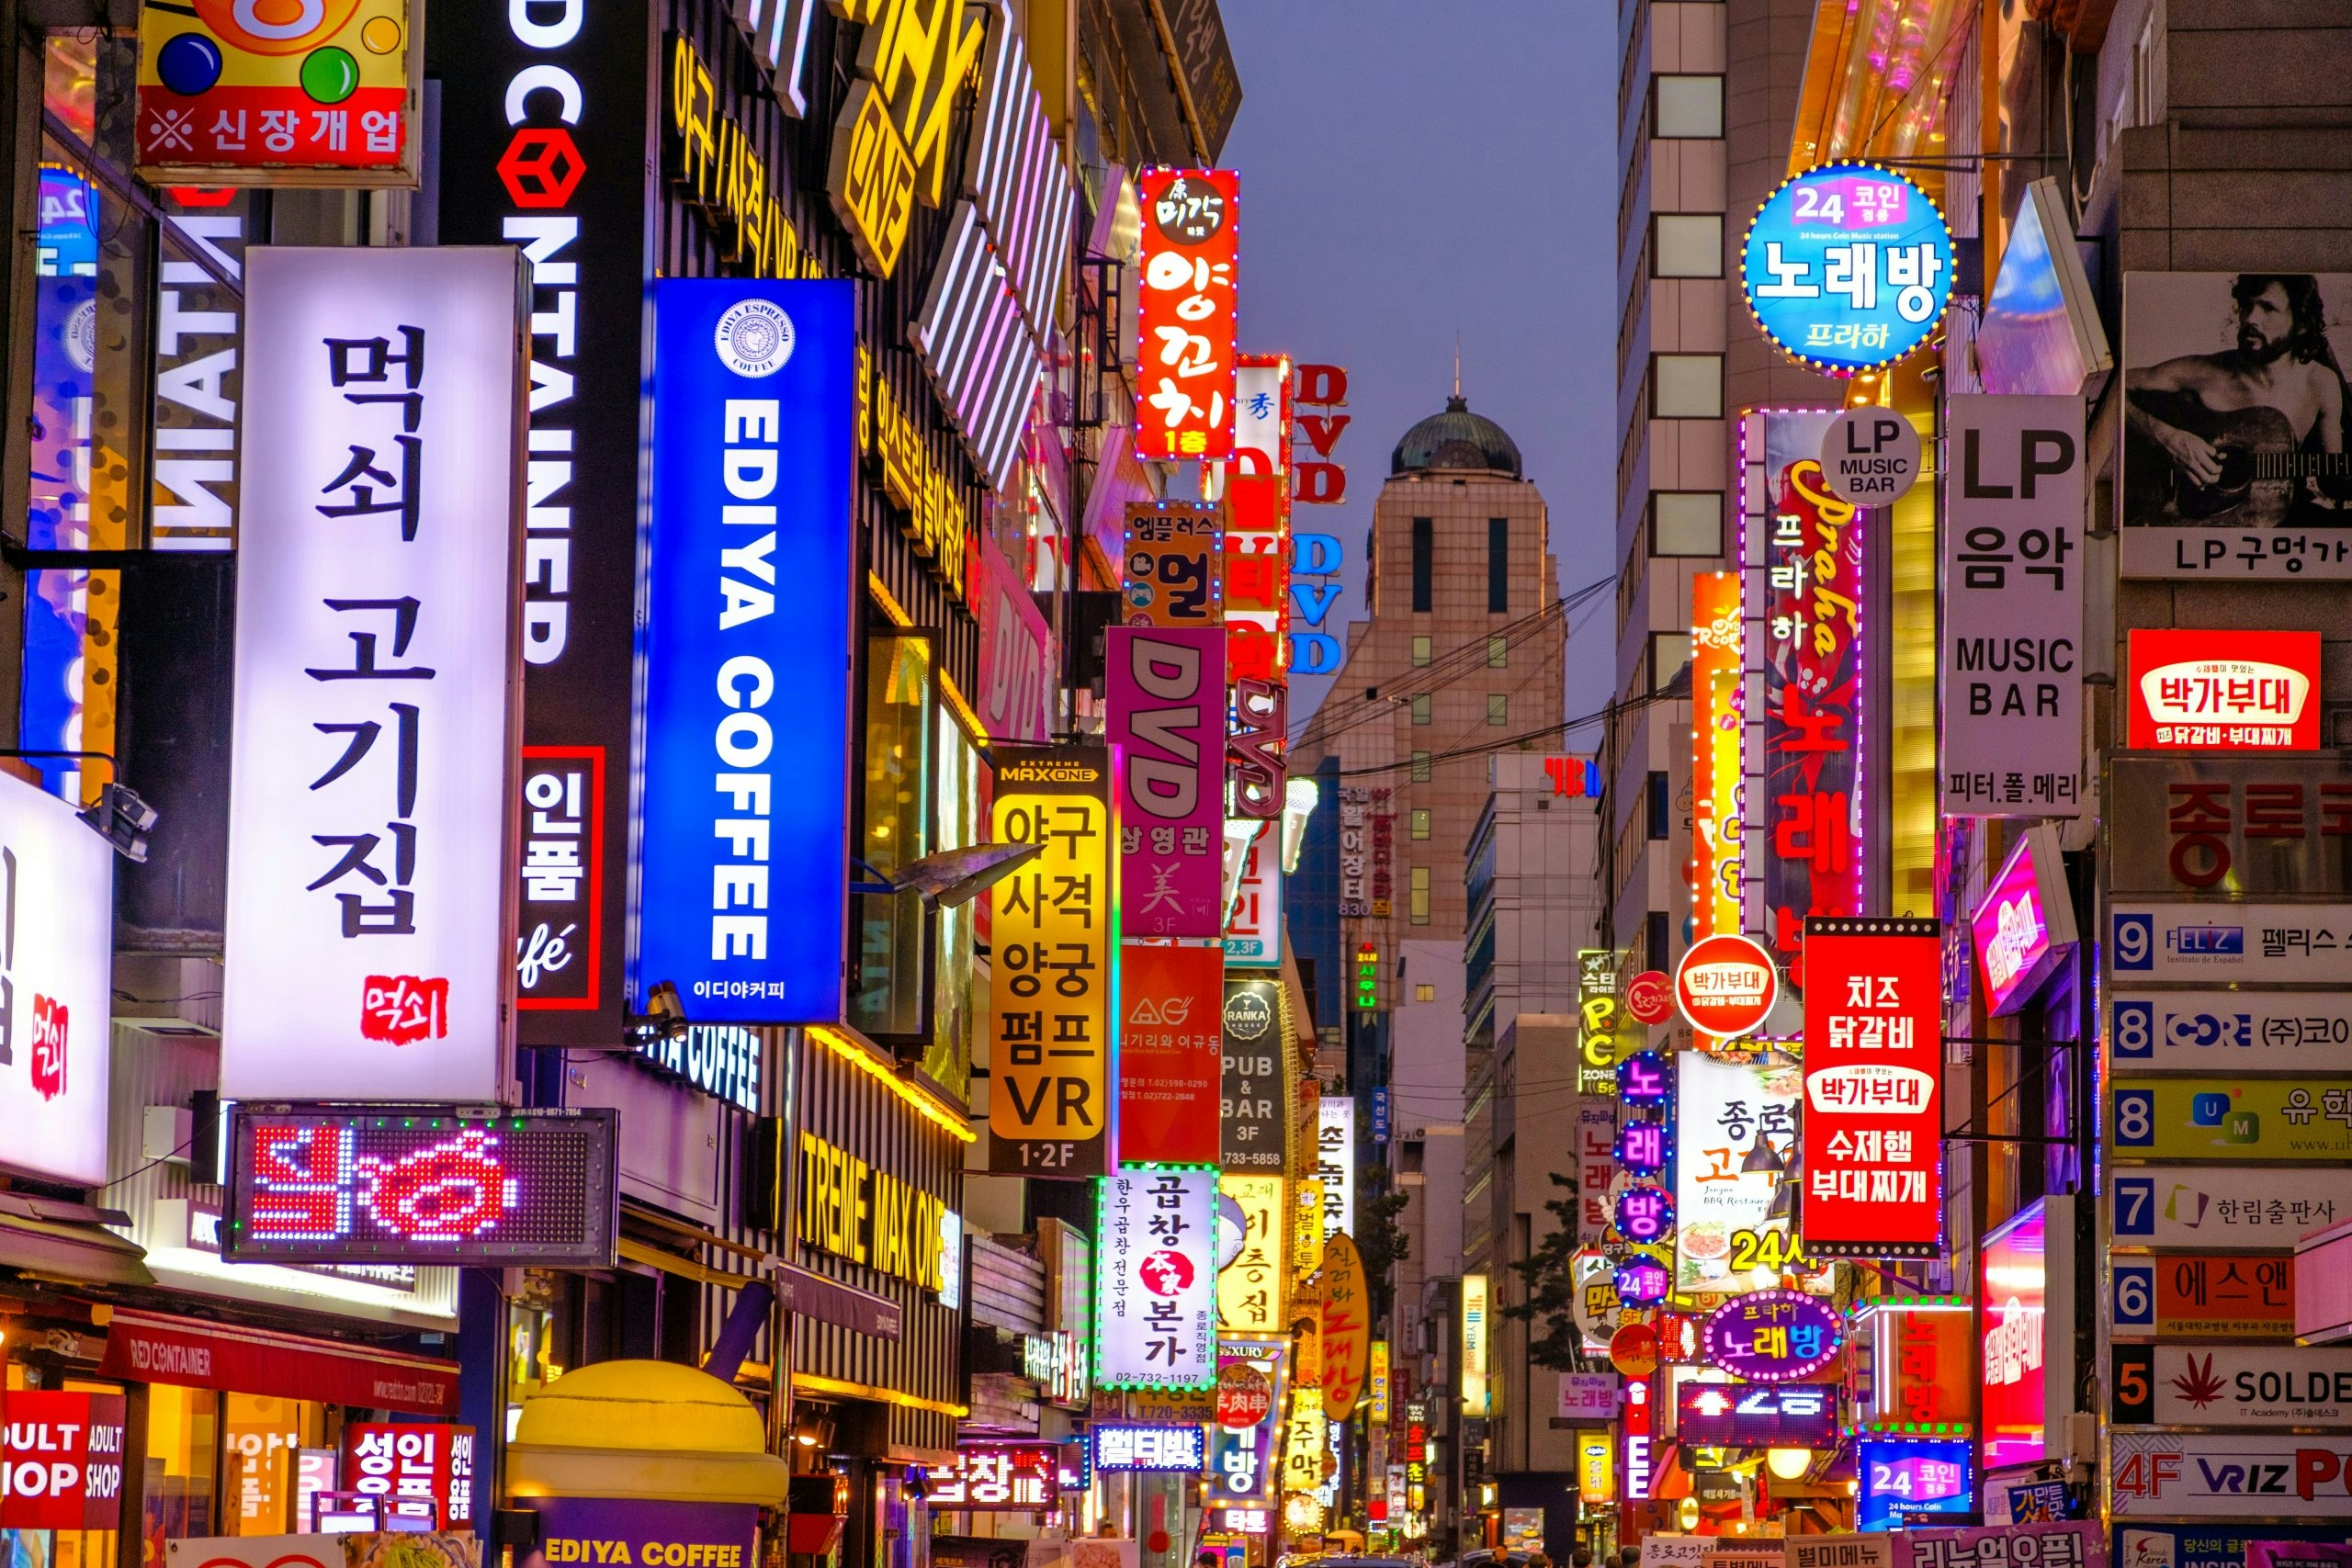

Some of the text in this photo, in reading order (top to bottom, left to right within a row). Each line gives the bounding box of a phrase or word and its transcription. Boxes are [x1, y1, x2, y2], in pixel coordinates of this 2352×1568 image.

[209, 108, 399, 152] 신장개업
[1794, 186, 1845, 224] 24
[1852, 184, 1900, 209] 코인
[1800, 231, 1899, 240] 24 hours Coin Music station
[1756, 242, 1943, 322] 노래방
[1147, 250, 1231, 428] 양꼬치
[1804, 323, 1890, 349] 프라하
[1164, 430, 1208, 454] 1층
[1292, 363, 1351, 504] DVD
[1847, 420, 1900, 455] LP
[1839, 458, 1908, 475] MUSIC
[1962, 428, 2076, 500] LP
[1849, 477, 1895, 493] BAR
[1133, 515, 1215, 541] 엠플러스
[1956, 526, 2075, 592] 음악
[2177, 539, 2226, 570] LP
[1770, 514, 1809, 650] 프라하
[1290, 533, 1344, 675] DVD
[304, 324, 435, 940] 먹쇠 고기집
[1956, 637, 2075, 673] MUSIC
[710, 399, 780, 961] EDIYA COFFEE
[2160, 677, 2291, 714] 박가부대
[1969, 682, 2060, 717] BAR
[1130, 635, 1203, 820] DVD
[1950, 771, 2078, 805] 피터.폴.메리
[522, 773, 584, 902] 인품
[1001, 872, 1093, 930] 사격
[1139, 861, 1186, 917] 美
[1152, 918, 1177, 934] 3F
[1338, 902, 1371, 917] 830
[1226, 941, 1259, 956] 2,3F
[2119, 921, 2148, 963] 9
[2261, 929, 2337, 957] 펠리스
[1001, 940, 1097, 998] 양궁
[2166, 955, 2244, 965] Instituto de Español
[693, 980, 786, 1001] 이디야커피
[1358, 964, 1376, 1003] 사우나
[1693, 970, 1760, 990] 박가부대
[1846, 976, 1900, 1009] 치즈
[366, 985, 439, 1032] 먹쇠
[1227, 1011, 1267, 1021] RANKA
[1001, 1010, 1096, 1066] 펌프
[1582, 997, 1615, 1066] PC
[1828, 1016, 1915, 1049] 닭갈비
[2119, 1009, 2149, 1051] 8
[687, 1025, 761, 1113] COFFEE
[1222, 1056, 1272, 1077] PUB
[1582, 1068, 1615, 1081] ZONE
[1002, 1076, 1095, 1128] VR
[1240, 1080, 1251, 1095] &
[1821, 1078, 1920, 1107] 박가부대
[1221, 1099, 1272, 1120] BAR
[1716, 1100, 1793, 1142] 종로
[2120, 1097, 2150, 1139] 8
[2205, 1101, 2217, 1117] U
[1236, 1126, 1260, 1141] 3F
[2233, 1120, 2249, 1135] M
[1623, 1060, 1668, 1237] 노래방
[1826, 1130, 1912, 1163] 수제햄
[1703, 1196, 1724, 1206] BBQ
[1812, 1169, 1927, 1203] 부대찌개
[1145, 1176, 1190, 1247] 곱창
[2120, 1187, 2148, 1226] 7
[2217, 1199, 2336, 1225] 한림출판사
[873, 1171, 912, 1280] MAX
[915, 1190, 945, 1292] ONE
[1111, 1179, 1133, 1318] 한우곱창전문점
[1145, 1254, 1184, 1294] 本家
[1235, 1208, 1277, 1325] 이층집
[1621, 1272, 1641, 1296] 24
[1644, 1270, 1664, 1285] 코인
[2175, 1261, 2288, 1306] 에스앤
[1743, 1303, 1799, 1323] 프라하
[2119, 1275, 2147, 1316] 6
[1142, 1300, 1187, 1368] 본가
[1623, 1311, 1639, 1324] 5F
[130, 1339, 151, 1370] RED
[1724, 1325, 1825, 1359] 노래방
[1115, 1372, 1199, 1384] 02-732-1197
[1901, 1311, 1941, 1423] 노래방
[2119, 1363, 2147, 1405] 5
[1565, 1389, 1613, 1408] 노래방
[2250, 1409, 2289, 1417] Academy
[88, 1425, 122, 1453] ADULT
[354, 1432, 435, 1476] 성인
[450, 1434, 472, 1476] 성인
[1292, 1420, 1317, 1480] 주막
[85, 1464, 120, 1499] SHOP
[1873, 1466, 1912, 1495] 24
[1917, 1464, 1955, 1483] 코인
[2115, 1451, 2183, 1499] 4F
[447, 1479, 471, 1521] 용품
[1888, 1503, 1941, 1511] 24 hours Coin
[545, 1538, 741, 1568] EDIYA COFFEE
[1797, 1544, 1880, 1568] 별미메뉴
[2184, 1540, 2222, 1553] 당신의
